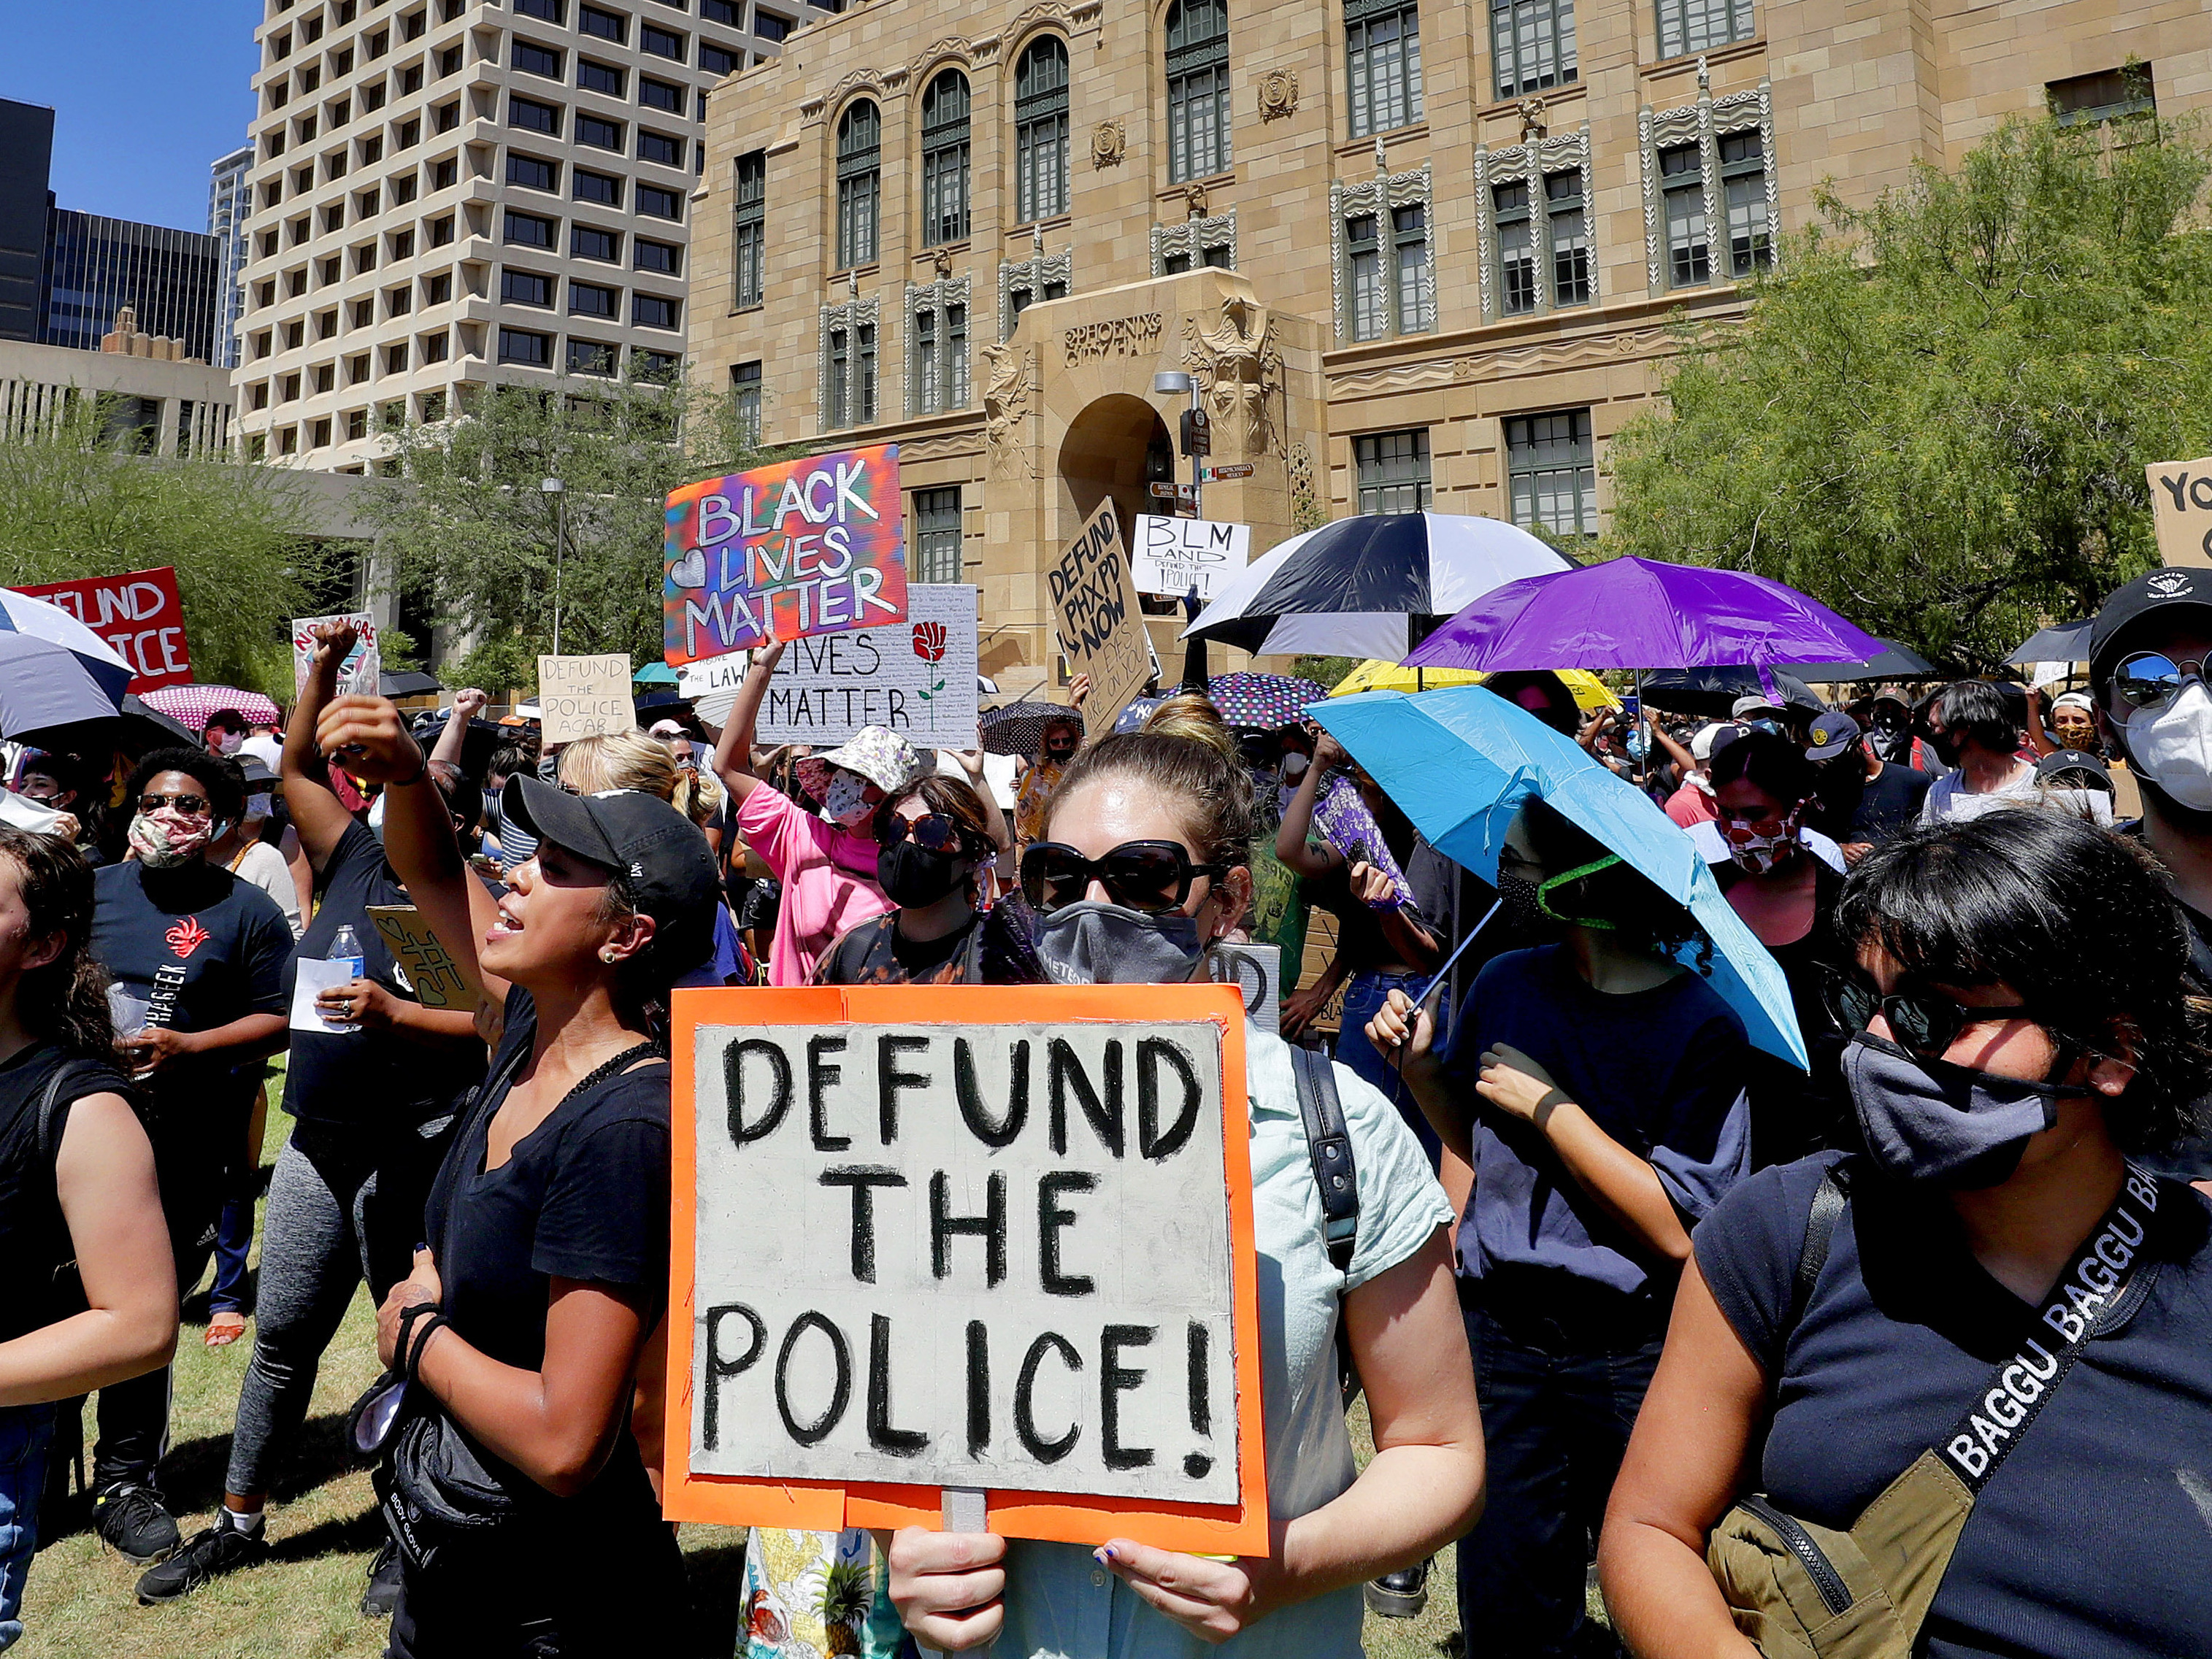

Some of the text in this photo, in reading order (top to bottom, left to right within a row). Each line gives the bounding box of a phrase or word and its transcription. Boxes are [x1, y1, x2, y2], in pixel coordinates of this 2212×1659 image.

[1065, 343, 1108, 368] CITY
[1077, 314, 1153, 343] PHOENIX
[696, 459, 880, 547] BLACK
[721, 526, 853, 592] LIVES
[1048, 512, 1115, 606] DEFUND
[34, 582, 165, 628] FUND
[685, 566, 899, 657] MATTER
[1064, 552, 1120, 636] PHXPD
[1080, 582, 1125, 661] NOW
[108, 626, 189, 676] ICE
[544, 659, 624, 680] DEFUND
[690, 674, 704, 682] THE
[710, 664, 746, 688] LAW
[772, 634, 880, 675] IVES
[1103, 621, 1133, 674] EYES
[2035, 661, 2067, 683] POLICE
[545, 698, 623, 720] POLICE
[567, 684, 594, 694] THE
[770, 688, 910, 728] MATTER
[1087, 639, 1144, 723] ARE ON YOU
[559, 717, 607, 734] ACAB
[722, 1033, 1203, 1162] DEFUND
[2123, 1155, 2159, 1212] BA
[818, 1163, 1102, 1296] THE
[2043, 1206, 2144, 1344] BAGGU
[702, 1305, 1211, 1480] POLICE!
[1946, 1337, 2059, 1479] BAGGU
[391, 1492, 422, 1557] BODY GLOVE
